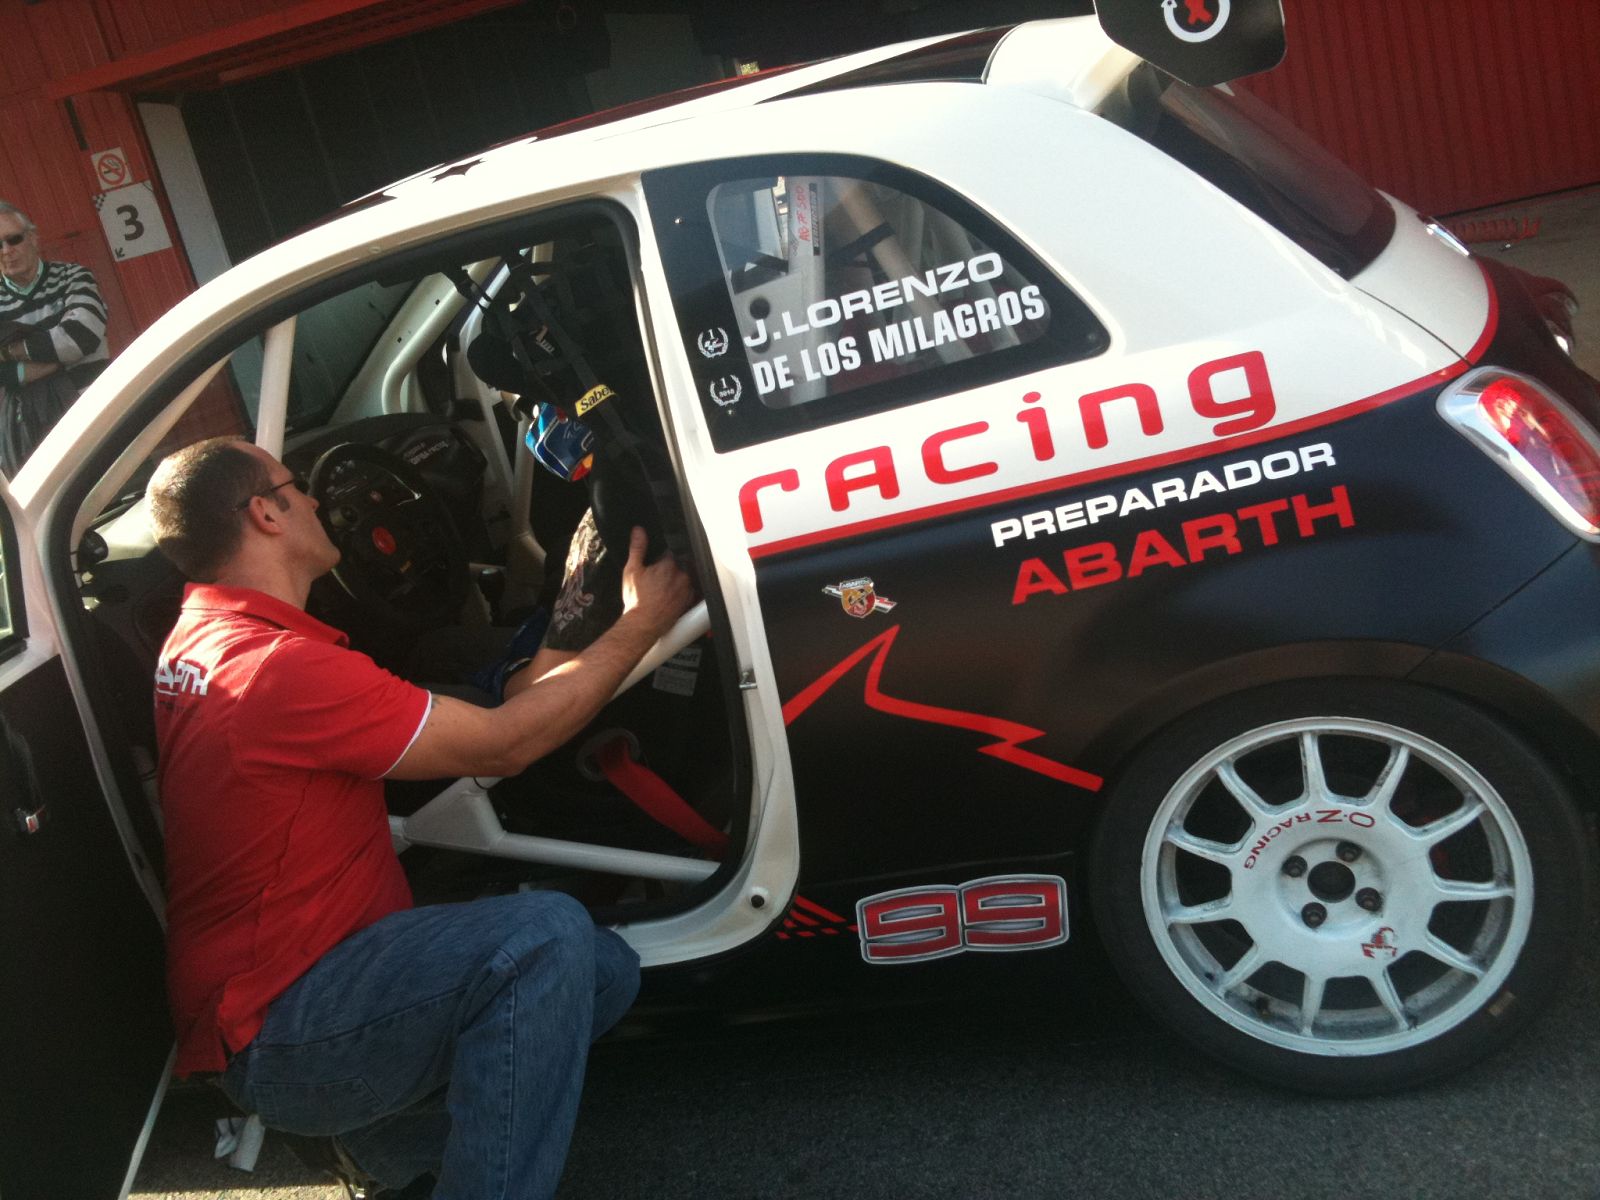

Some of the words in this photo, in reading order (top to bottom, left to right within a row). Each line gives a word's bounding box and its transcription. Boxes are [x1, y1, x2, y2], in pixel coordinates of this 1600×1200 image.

[115, 204, 145, 241] 3
[743, 252, 1004, 347] J.LORENZO
[752, 354, 794, 395] DE
[800, 336, 861, 382] LOS
[867, 284, 1045, 363] MILAGROS
[991, 442, 1336, 547] PREPARADOR
[1011, 484, 1355, 605] ABARTH
[1243, 812, 1312, 870] RACING
[855, 873, 1070, 965] 99
